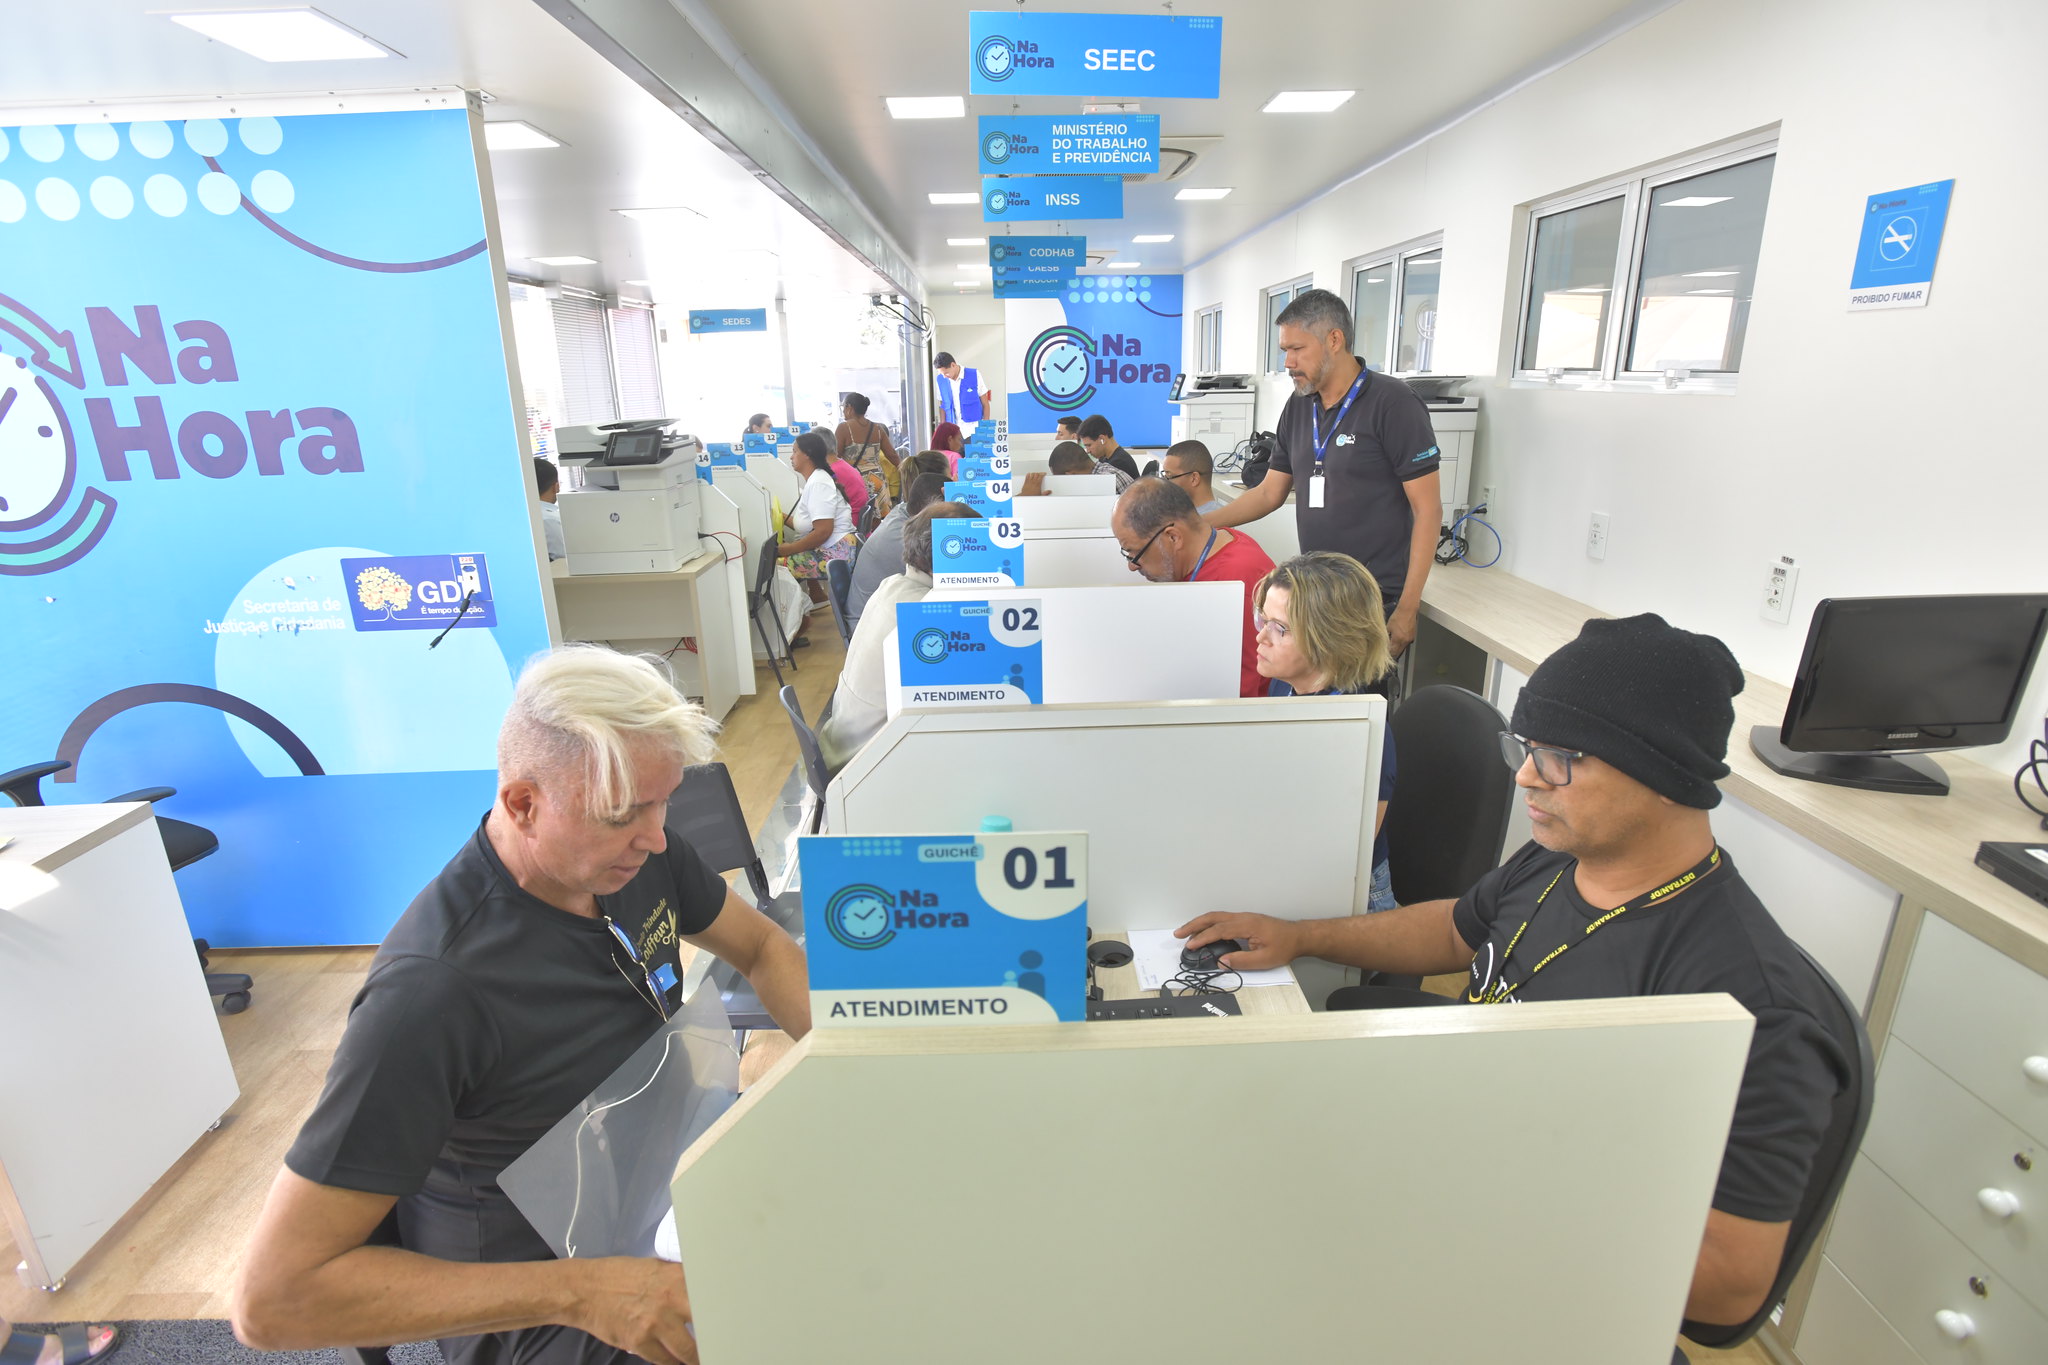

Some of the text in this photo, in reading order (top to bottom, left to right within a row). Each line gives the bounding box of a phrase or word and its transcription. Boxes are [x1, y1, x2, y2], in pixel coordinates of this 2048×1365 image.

[1017, 40, 1038, 53] Na
[1013, 54, 1055, 68] Hora
[1084, 48, 1156, 71] SEEC
[1052, 122, 1127, 136] MINISTÉRIO
[1012, 135, 1027, 144] Na
[1052, 138, 1147, 150] DO TRABALHO
[1009, 144, 1039, 154] Hora
[1053, 149, 1152, 164] E PREVIDÊNCIA
[1007, 198, 1030, 207] Hora
[1045, 193, 1080, 206] INSS
[1029, 248, 1075, 257] CODHAB
[1852, 290, 1922, 304] PROIBIDO FUMAR
[722, 318, 751, 326] SEDES
[84, 304, 239, 387] Na
[1102, 334, 1142, 357] Na
[1095, 359, 1171, 384] Hora
[83, 395, 365, 482] Hora
[996, 445, 1008, 453] 06
[995, 459, 1010, 469] 05
[992, 482, 1010, 494] 04
[997, 522, 1021, 538] 03
[962, 544, 987, 552] Hora
[940, 576, 999, 584] ATENDIMENTO
[416, 580, 466, 604] GD
[243, 597, 341, 615] Secretaria de
[421, 605, 428, 615] É
[428, 607, 452, 615] tempo
[963, 607, 991, 615] GUICHÊ
[1002, 608, 1039, 632] 02
[203, 619, 257, 636] Justiça
[260, 620, 269, 632] e
[950, 631, 970, 641] Na
[947, 642, 986, 652] Hora
[913, 690, 1005, 702] ATENDIMENTO
[924, 846, 979, 859] GUICHÊ
[1003, 846, 1075, 890] 01
[1650, 872, 1696, 900] DETRAN/DF
[900, 890, 938, 908] Na
[894, 910, 969, 929] Hora
[1585, 906, 1626, 934] DETRAN/DF
[1533, 944, 1568, 973] DETRAN/DF
[830, 998, 1008, 1018] ATENDIMENTO
